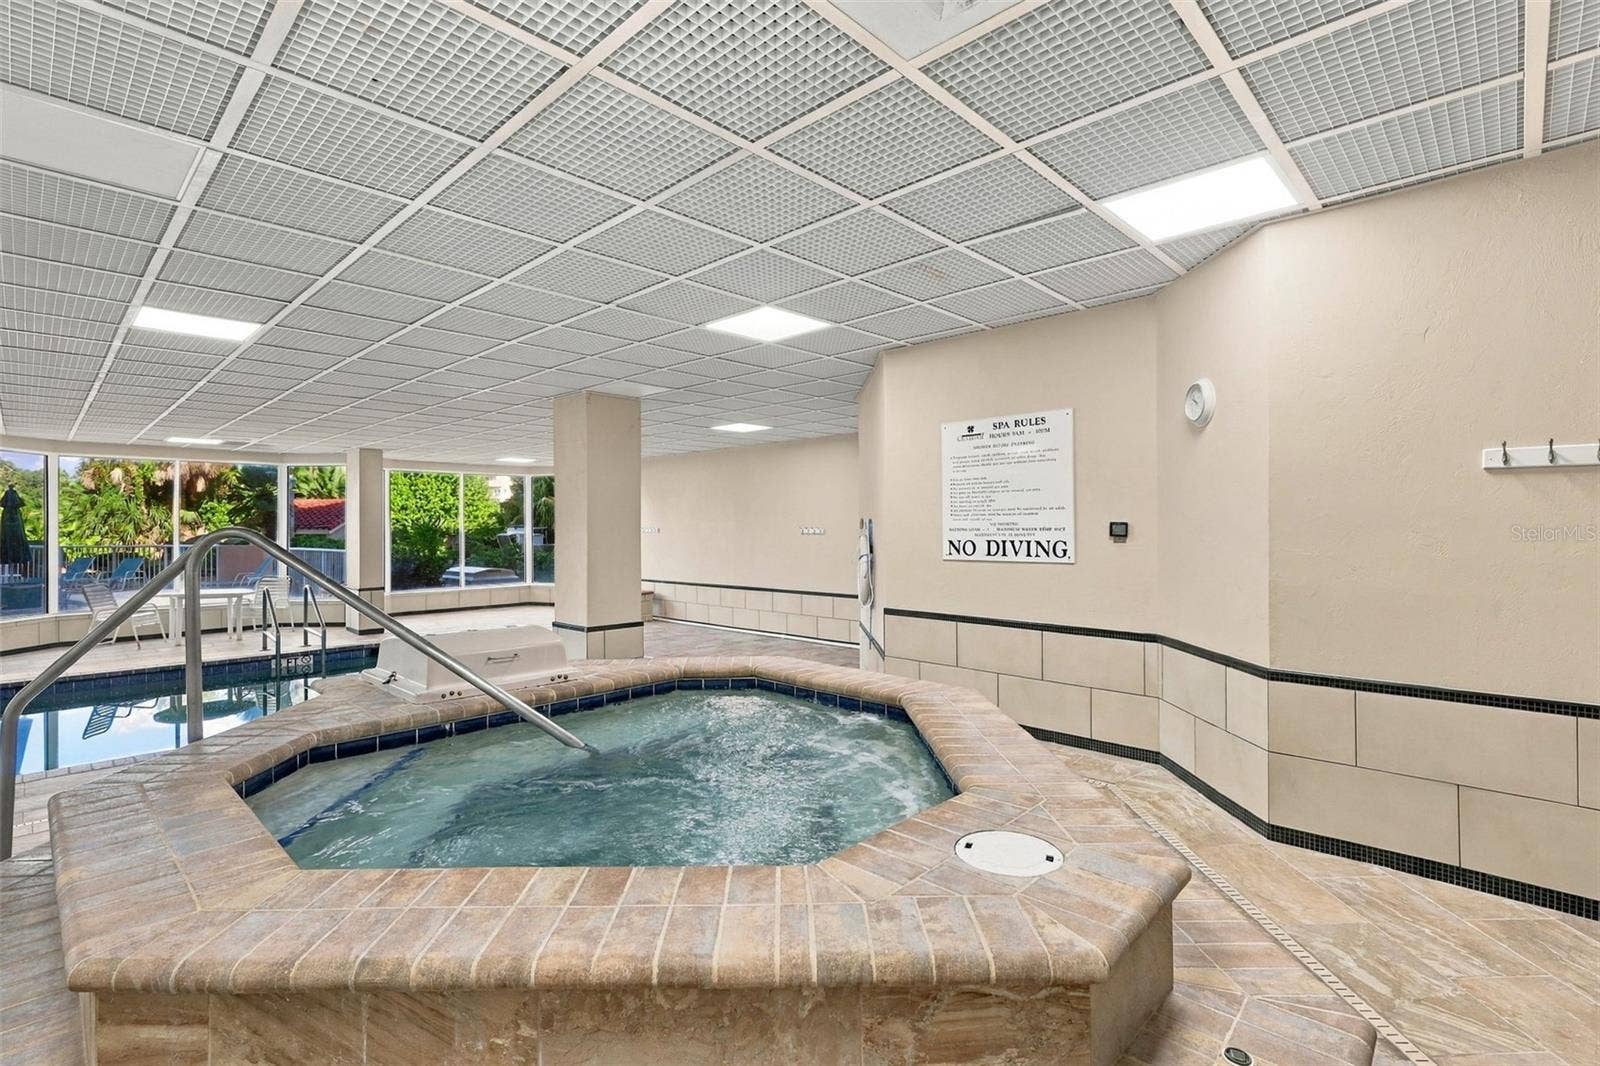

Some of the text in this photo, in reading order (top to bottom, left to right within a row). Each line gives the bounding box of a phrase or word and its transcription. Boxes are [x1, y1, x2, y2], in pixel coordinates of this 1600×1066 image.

[992, 416, 1047, 430] SPA RULES
[989, 431, 1010, 439] HOURS
[948, 539, 977, 557] NO
